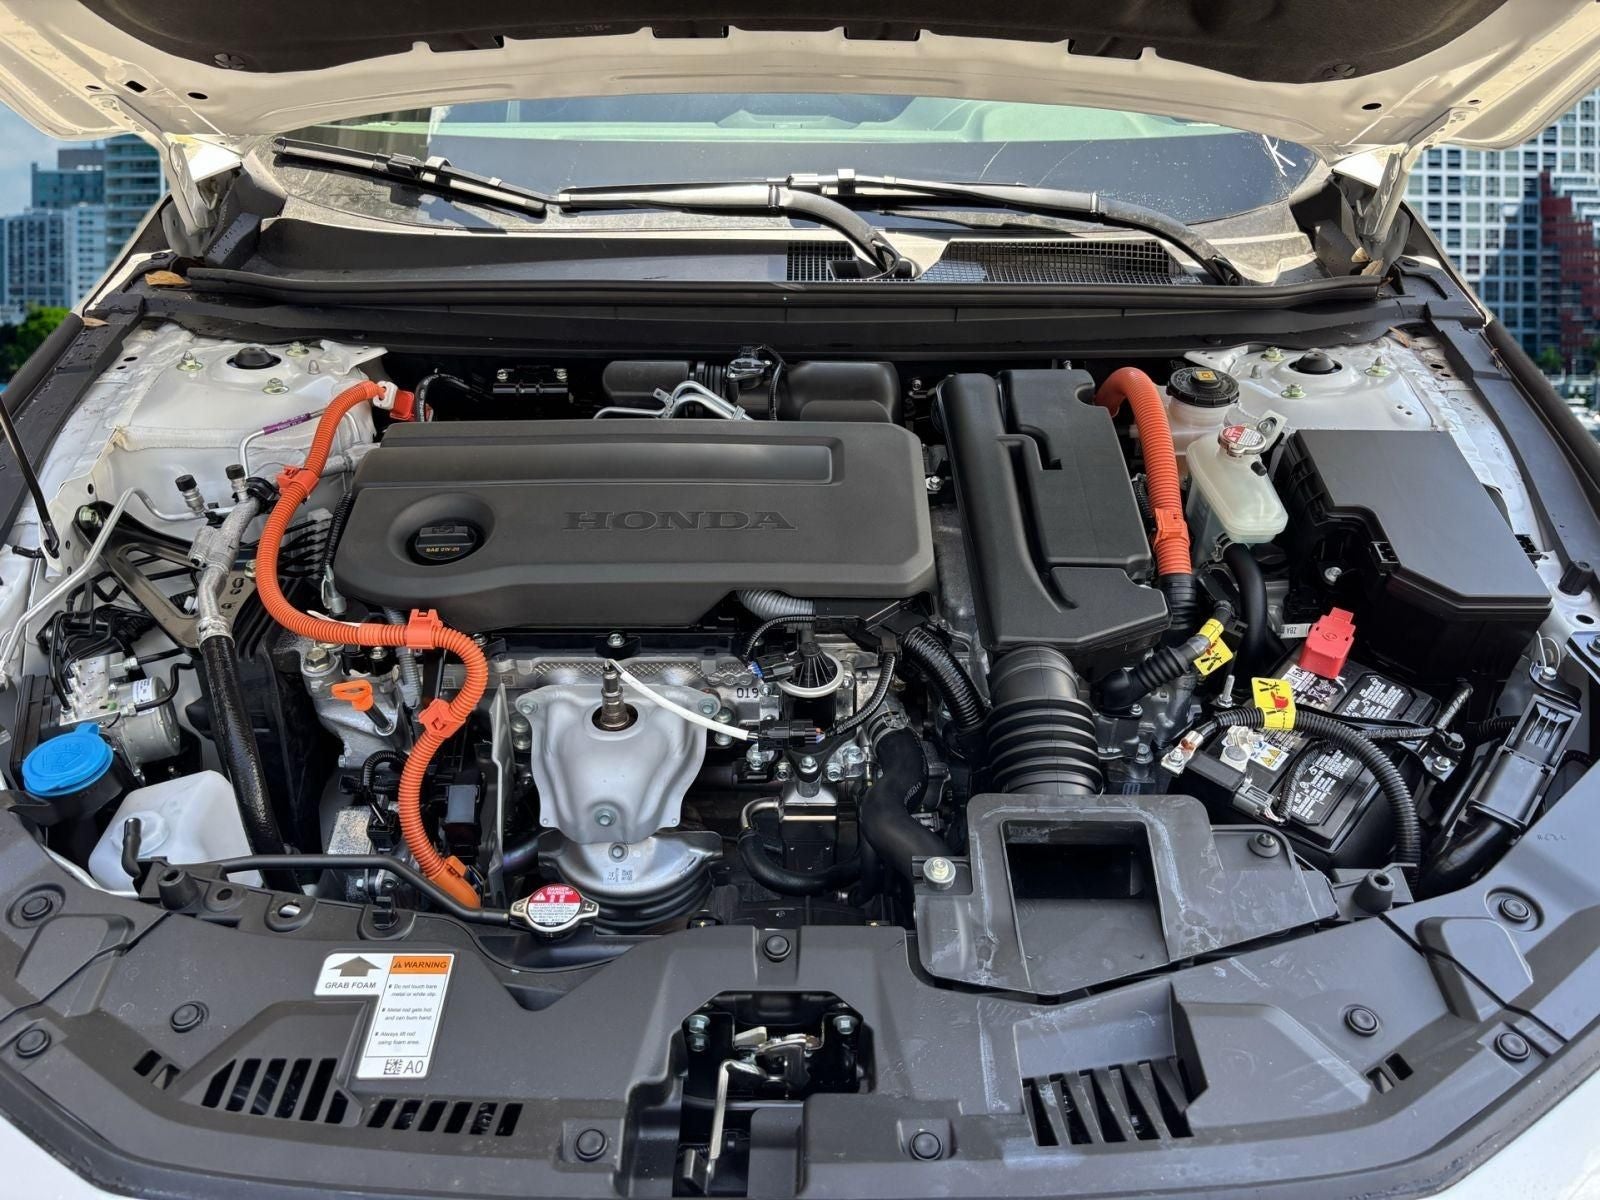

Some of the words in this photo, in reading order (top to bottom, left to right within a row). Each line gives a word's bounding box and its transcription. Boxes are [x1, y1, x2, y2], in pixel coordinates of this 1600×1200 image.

[562, 511, 798, 531] HONDA
[404, 961, 447, 969] WARNING
[325, 981, 349, 989] GRAB
[351, 981, 377, 989] FOAM
[403, 1060, 424, 1074] A0
